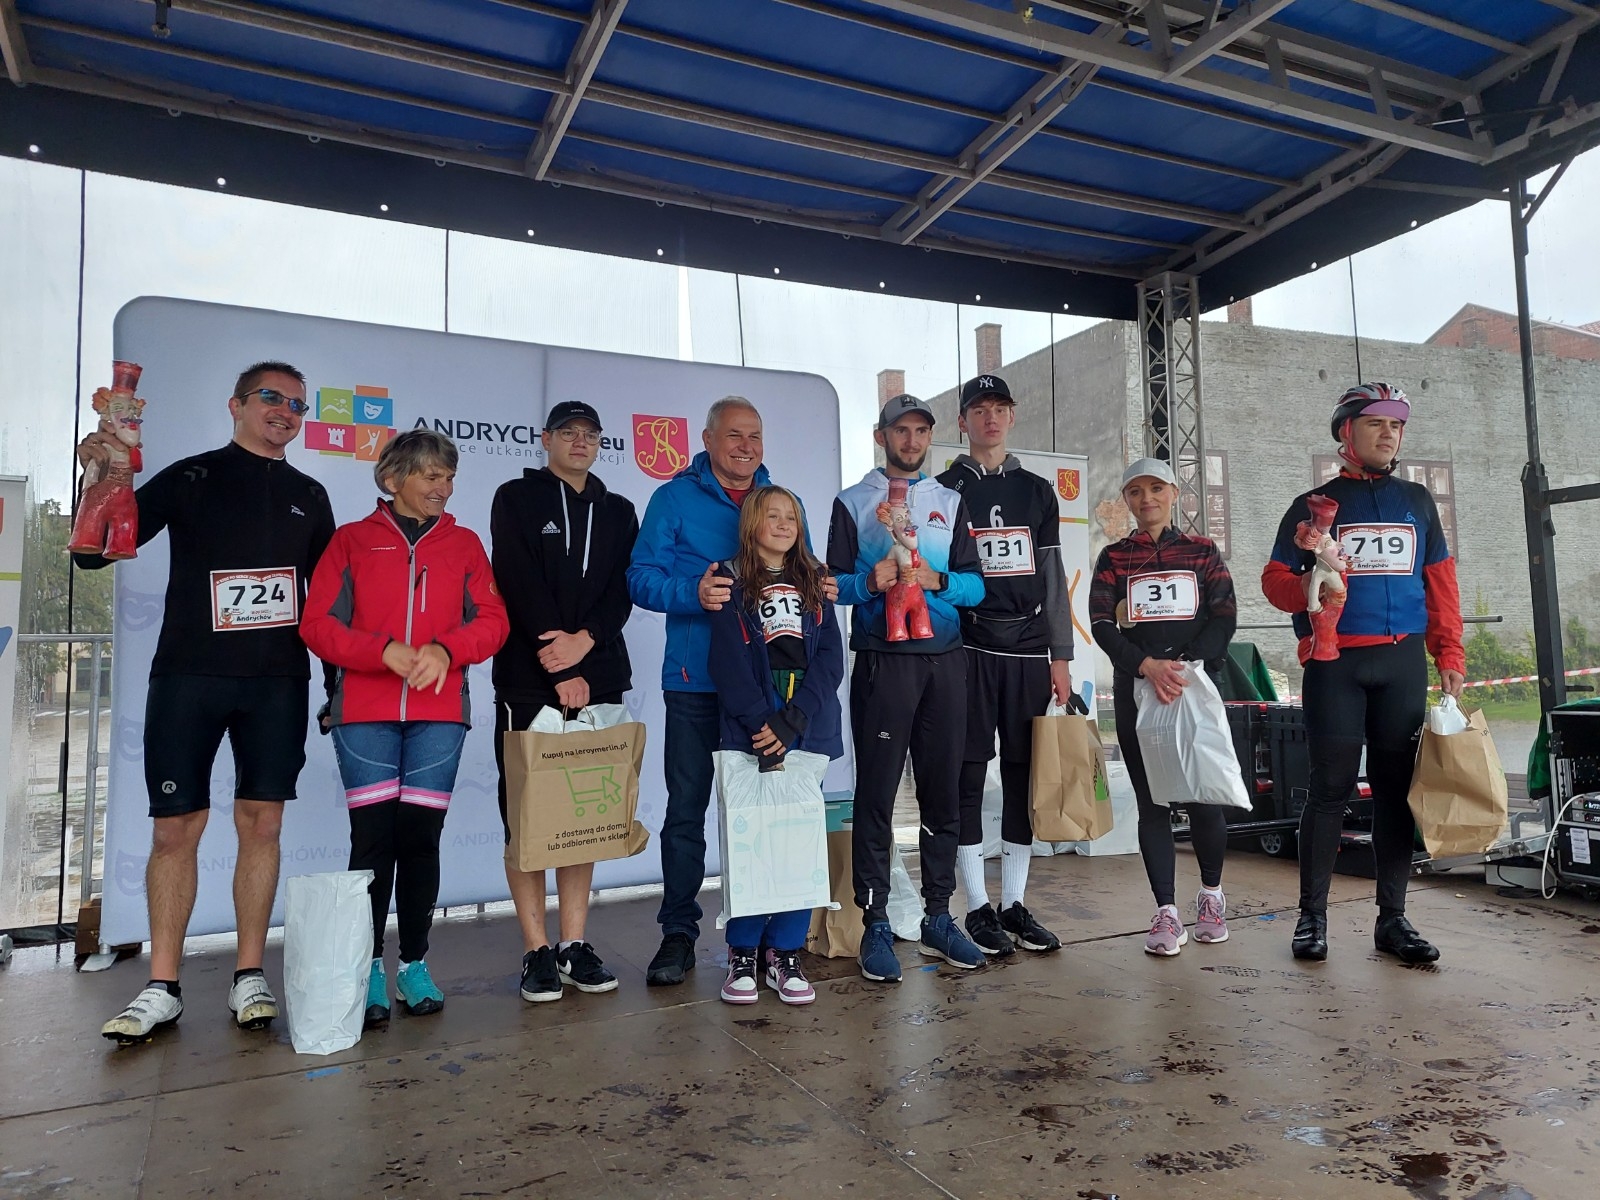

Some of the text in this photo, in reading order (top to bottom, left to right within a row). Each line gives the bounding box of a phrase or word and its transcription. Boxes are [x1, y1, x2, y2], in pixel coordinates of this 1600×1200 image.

[485, 444, 543, 459] utkane
[982, 539, 1023, 558] 131
[1351, 536, 1404, 555] 719
[228, 583, 286, 607] 724
[1148, 583, 1178, 602] 31
[760, 597, 803, 619] 613
[541, 750, 564, 760] Kupuj
[575, 741, 629, 756] leroymerlin.pl
[596, 824, 606, 833] do
[606, 822, 627, 832] domu
[547, 842, 561, 851] lub
[561, 837, 598, 849] odbiorem
